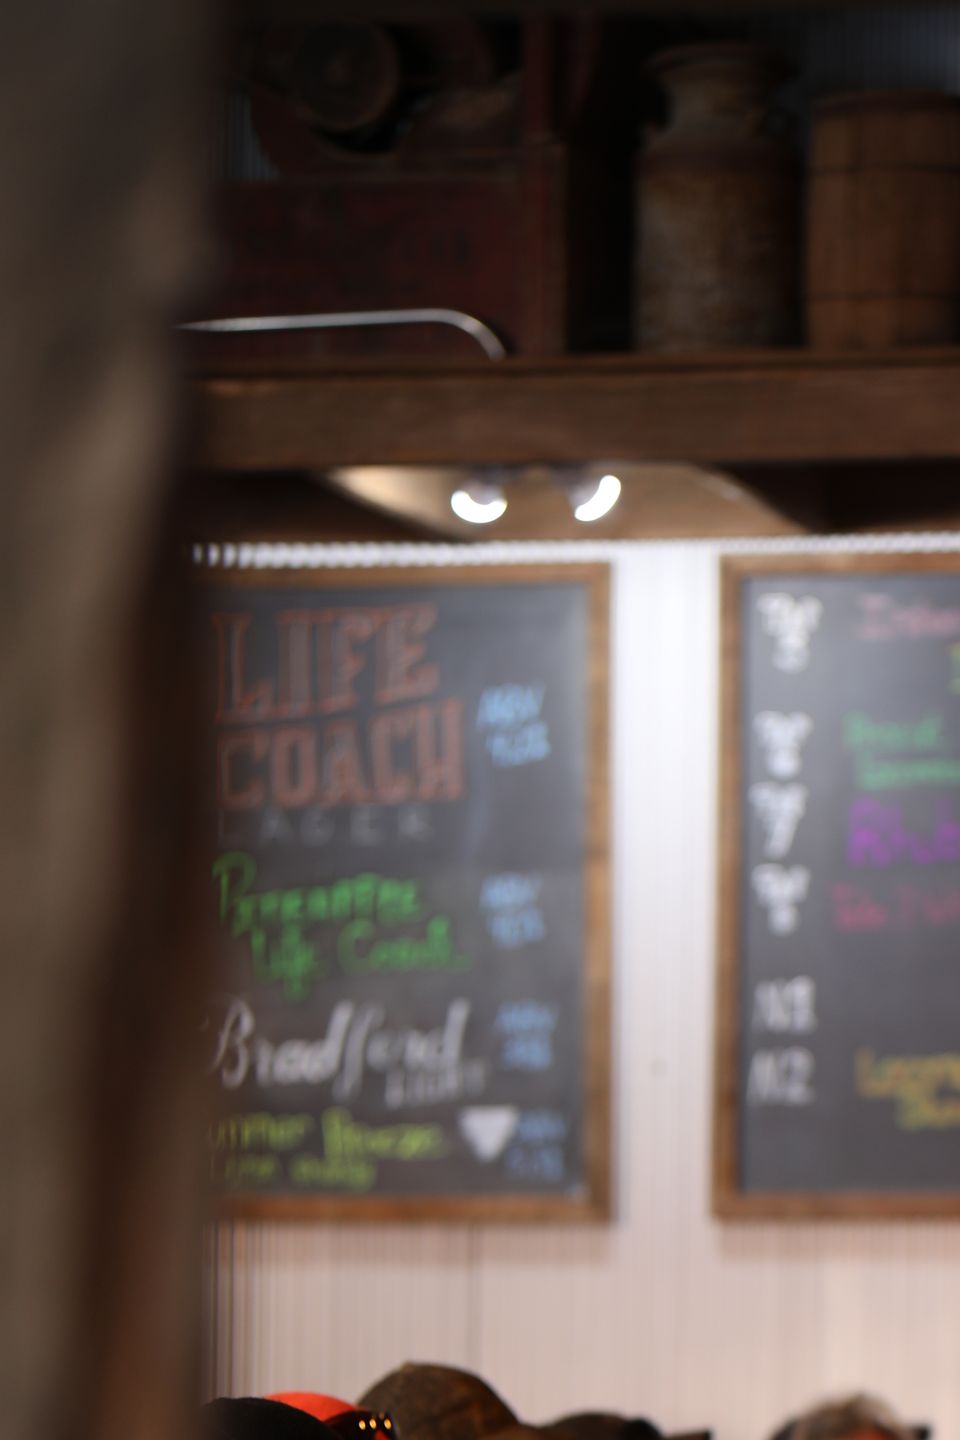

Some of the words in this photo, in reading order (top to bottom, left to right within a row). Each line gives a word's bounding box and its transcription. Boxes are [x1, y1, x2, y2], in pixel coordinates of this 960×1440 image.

[211, 602, 440, 722] LIFE
[216, 698, 466, 811] COACH
[211, 998, 472, 1098] Bradford
